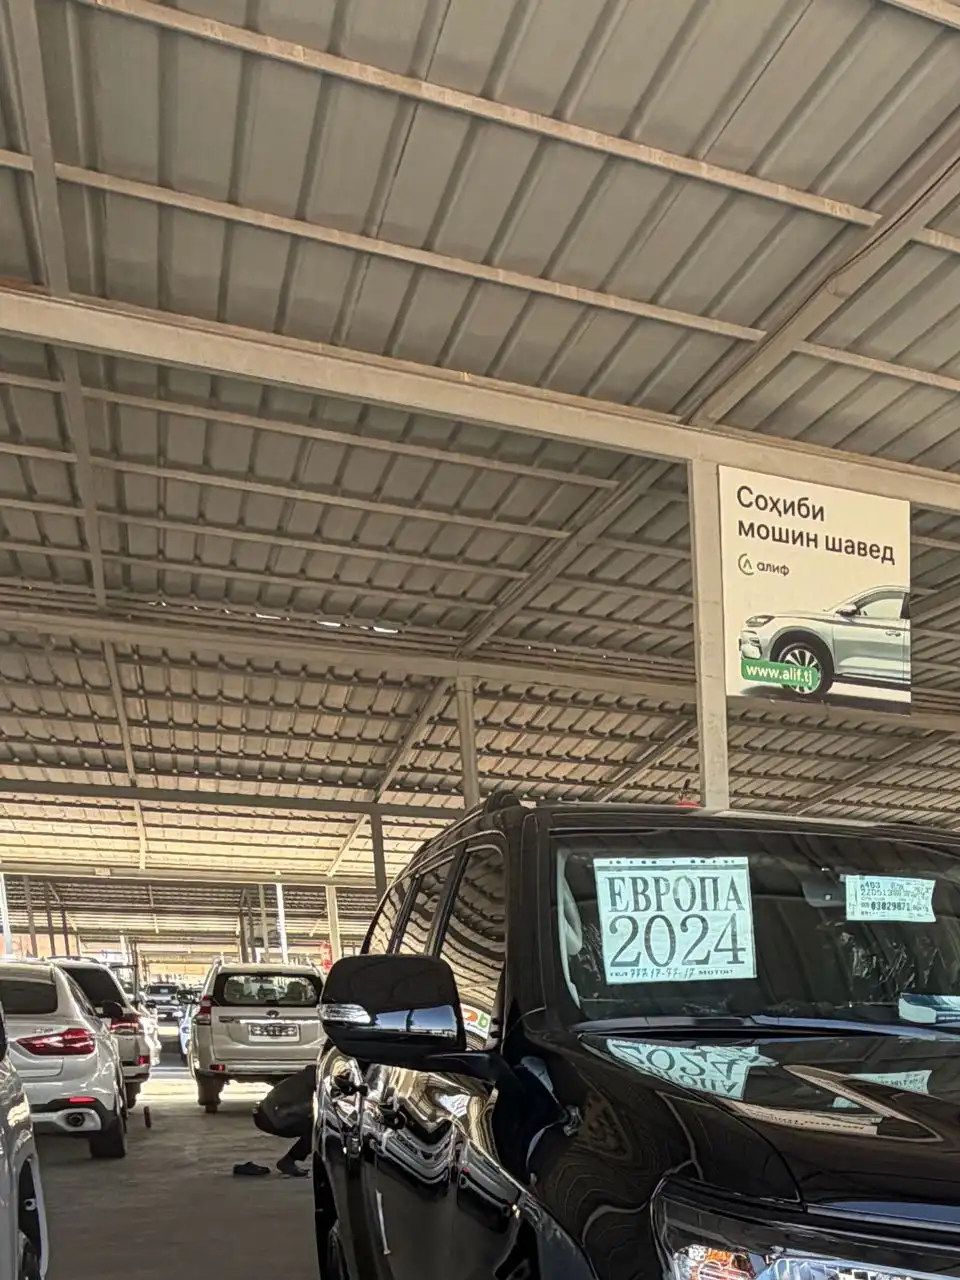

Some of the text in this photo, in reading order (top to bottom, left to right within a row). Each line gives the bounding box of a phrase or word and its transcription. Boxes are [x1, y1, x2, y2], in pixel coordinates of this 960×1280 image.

[737, 485, 825, 522] Соҳиби
[738, 520, 896, 566] мошин шавед
[756, 560, 790, 577] алиф
[746, 664, 813, 684] www.alif.tj
[605, 875, 745, 913] ЕВРОПА
[609, 913, 747, 968] 2024
